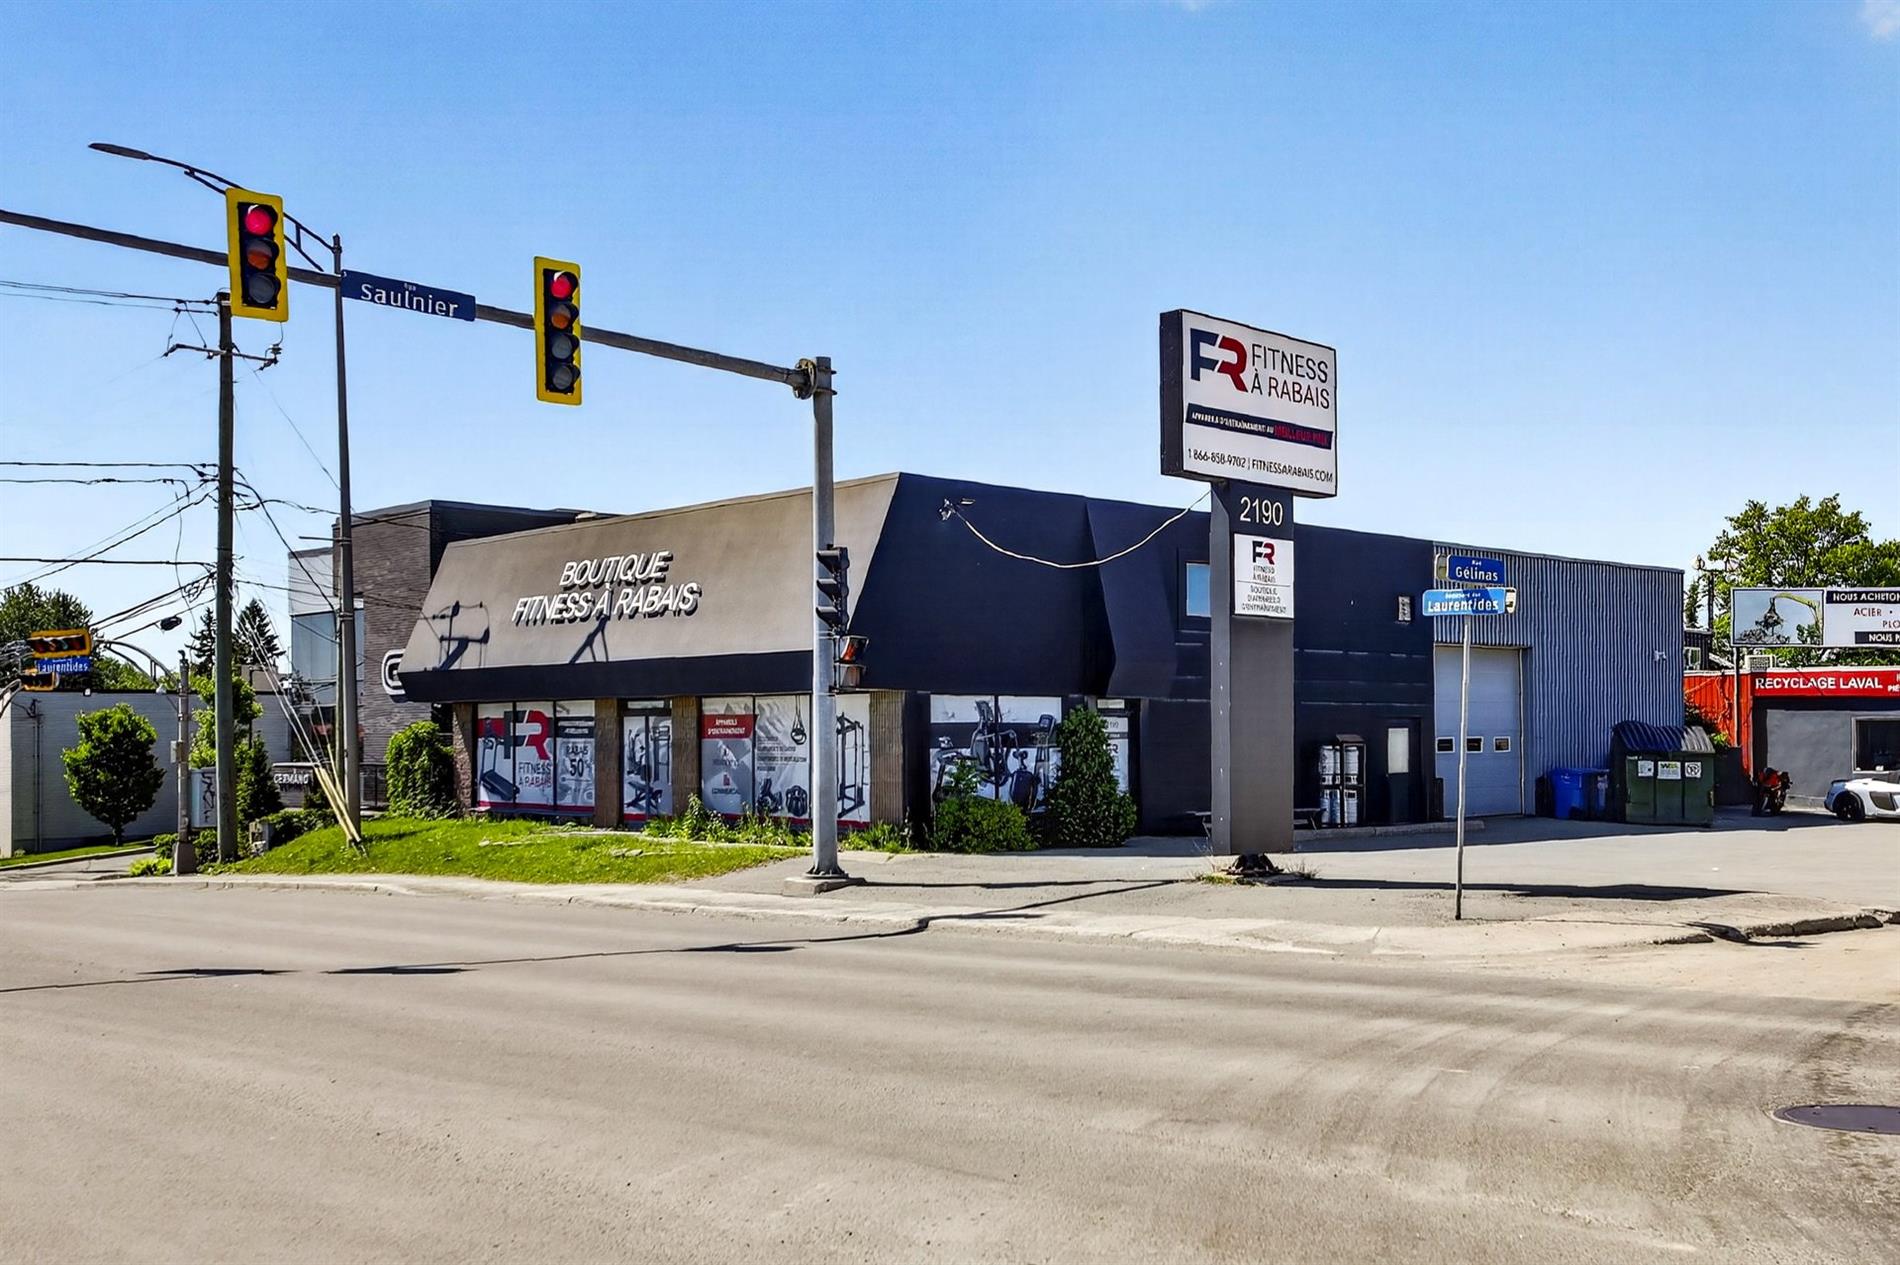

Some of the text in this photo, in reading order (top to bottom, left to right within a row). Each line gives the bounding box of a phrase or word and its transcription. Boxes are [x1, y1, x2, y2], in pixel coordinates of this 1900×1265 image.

[360, 283, 459, 317] Saulnier
[1189, 327, 1248, 392] FR
[1251, 343, 1329, 384] FITNESS
[1250, 368, 1330, 410] À RABAIS
[1251, 459, 1333, 482] FITNESSARABAIS.COM
[1239, 496, 1283, 526] 2190
[1252, 540, 1275, 565] FR
[559, 550, 671, 586] BOUTIQUE
[1455, 566, 1498, 581] Gélinas
[511, 582, 699, 623] FITNESS À RABAIS
[1427, 598, 1499, 613] Laurentides
[1833, 592, 1858, 602] NOUS
[1853, 607, 1882, 617] ACIER
[1868, 633, 1893, 642] NOUS
[1755, 677, 1836, 690] RECYCLAGE
[1839, 677, 1883, 690] LAVAL
[518, 761, 552, 775] FITNESS
